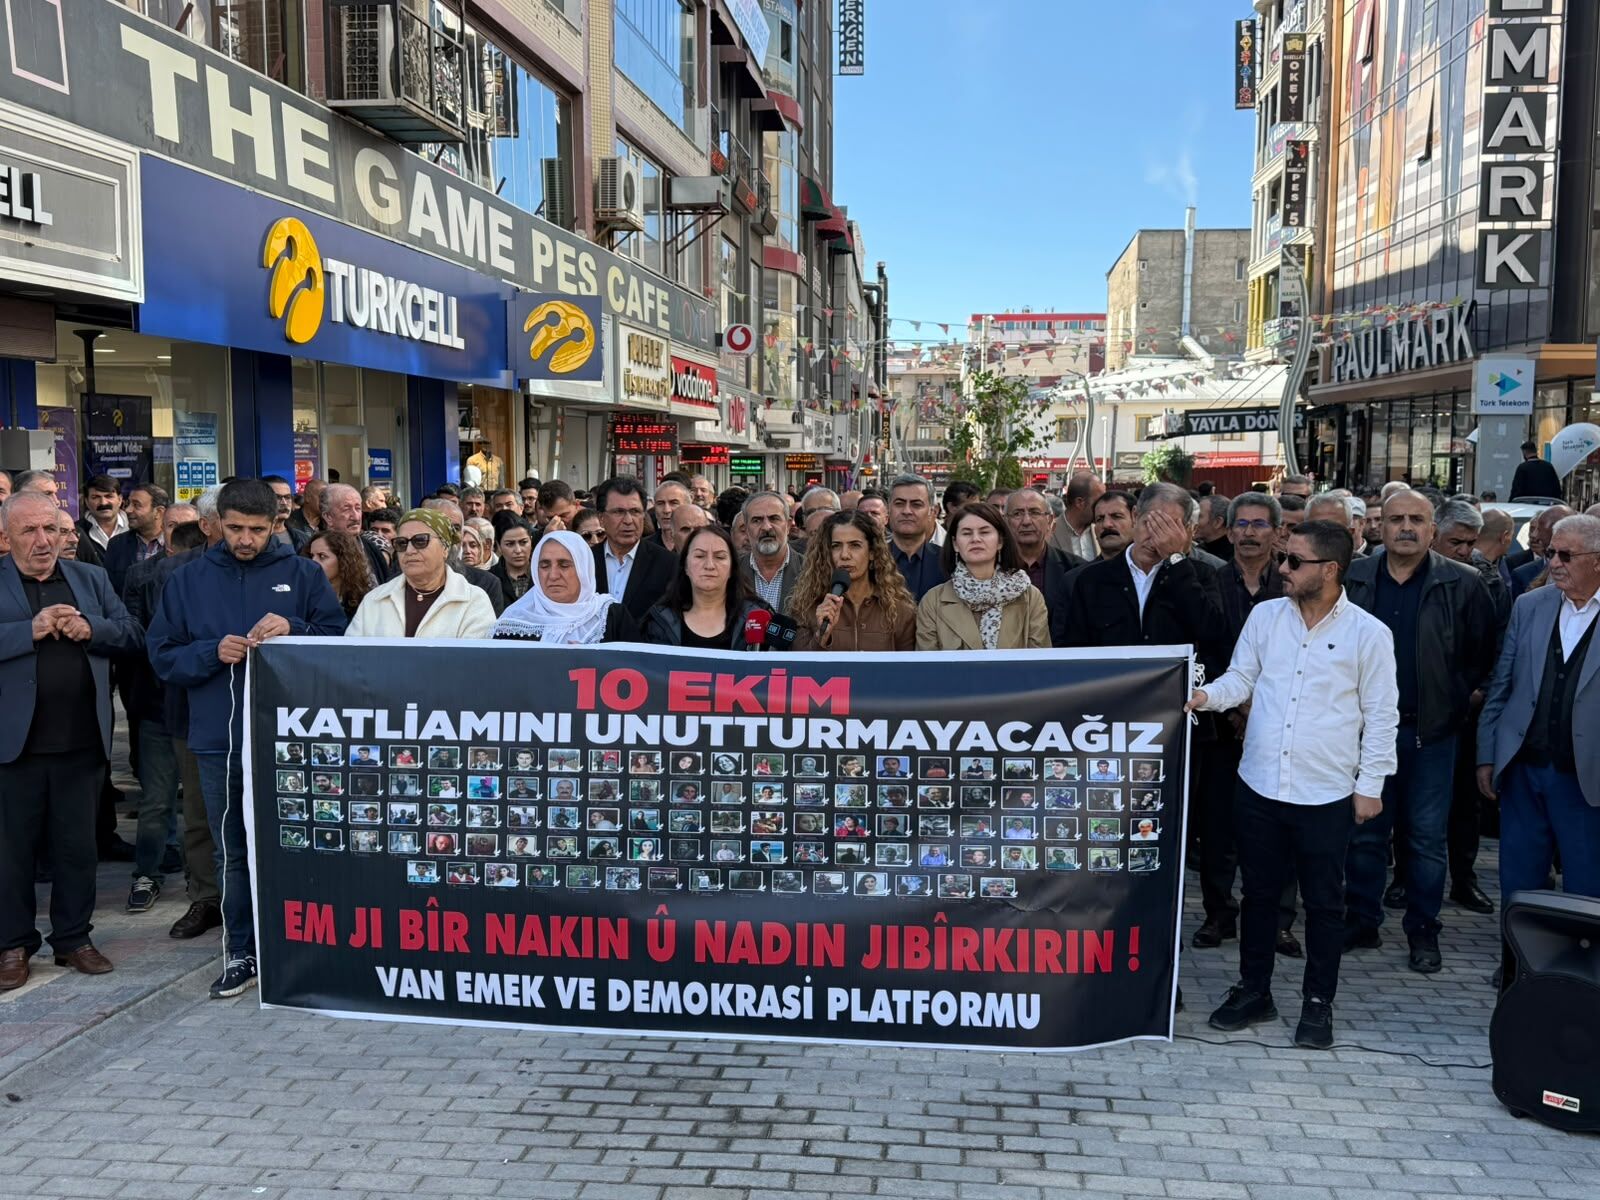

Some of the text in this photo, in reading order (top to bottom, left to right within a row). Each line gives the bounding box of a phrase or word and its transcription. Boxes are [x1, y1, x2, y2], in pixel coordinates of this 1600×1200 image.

[1485, 0, 1548, 284] MARK
[120, 23, 335, 203] THE
[354, 147, 516, 275] GAME
[531, 227, 598, 296] PES
[607, 265, 670, 331] CAFE
[322, 257, 465, 349] TURKCELL
[1334, 299, 1474, 382] PAULMARK
[677, 368, 713, 403] vodafone
[1480, 399, 1530, 407] Türk Telekom
[1188, 410, 1303, 432] YAYLA DÖNR
[569, 668, 851, 716] 10 EKİM
[276, 703, 1164, 754] KATLİAMINI UNUTTURMAYACAĞIZ
[284, 899, 337, 947] EM
[348, 906, 384, 950] JI
[399, 896, 471, 954] BÎR
[485, 911, 630, 960] NAKIN
[647, 904, 677, 963] Û
[694, 919, 845, 968] NADIN
[861, 911, 1115, 974] JIBÎRKIRIN
[375, 966, 1042, 1030] VAN EMEK VE DEMOKRASİ PLATFORMU
